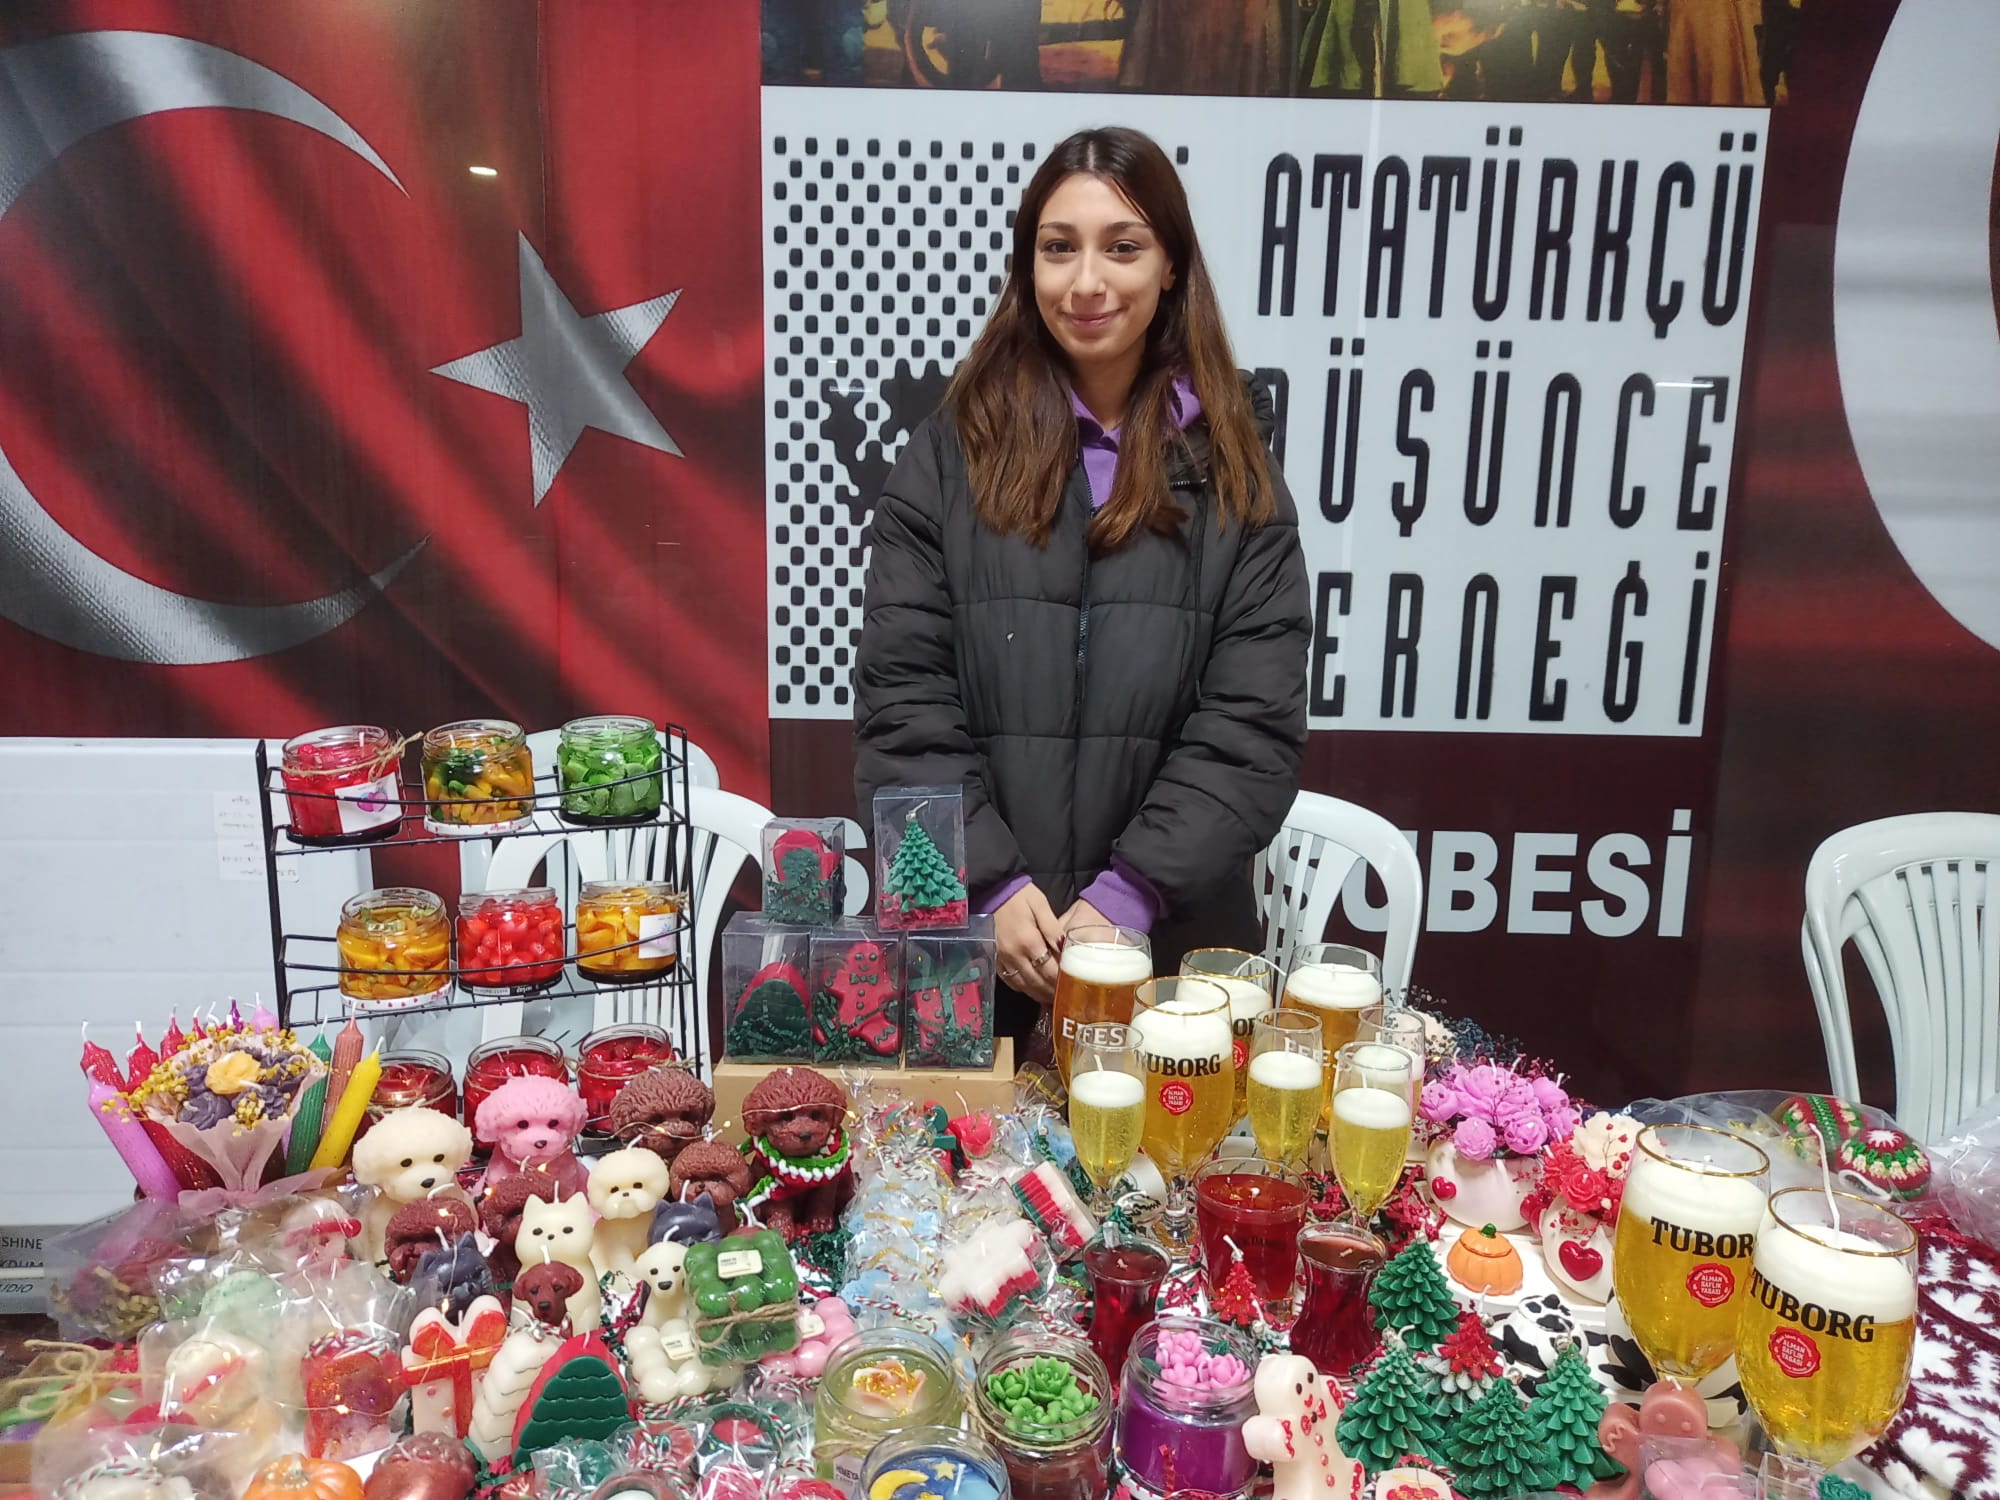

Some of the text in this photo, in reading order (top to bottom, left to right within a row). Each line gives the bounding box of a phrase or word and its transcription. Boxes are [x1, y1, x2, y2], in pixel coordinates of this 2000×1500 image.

[1257, 126, 1758, 339] ATATÜRKÇÜ
[1308, 550, 1710, 725] ERNEĞİ
[1061, 1016, 1125, 1047] EFES
[0, 1236, 44, 1250] SHINE
[1650, 1215, 1754, 1259] TUBOR
[1750, 1265, 1875, 1343] TUBORG
